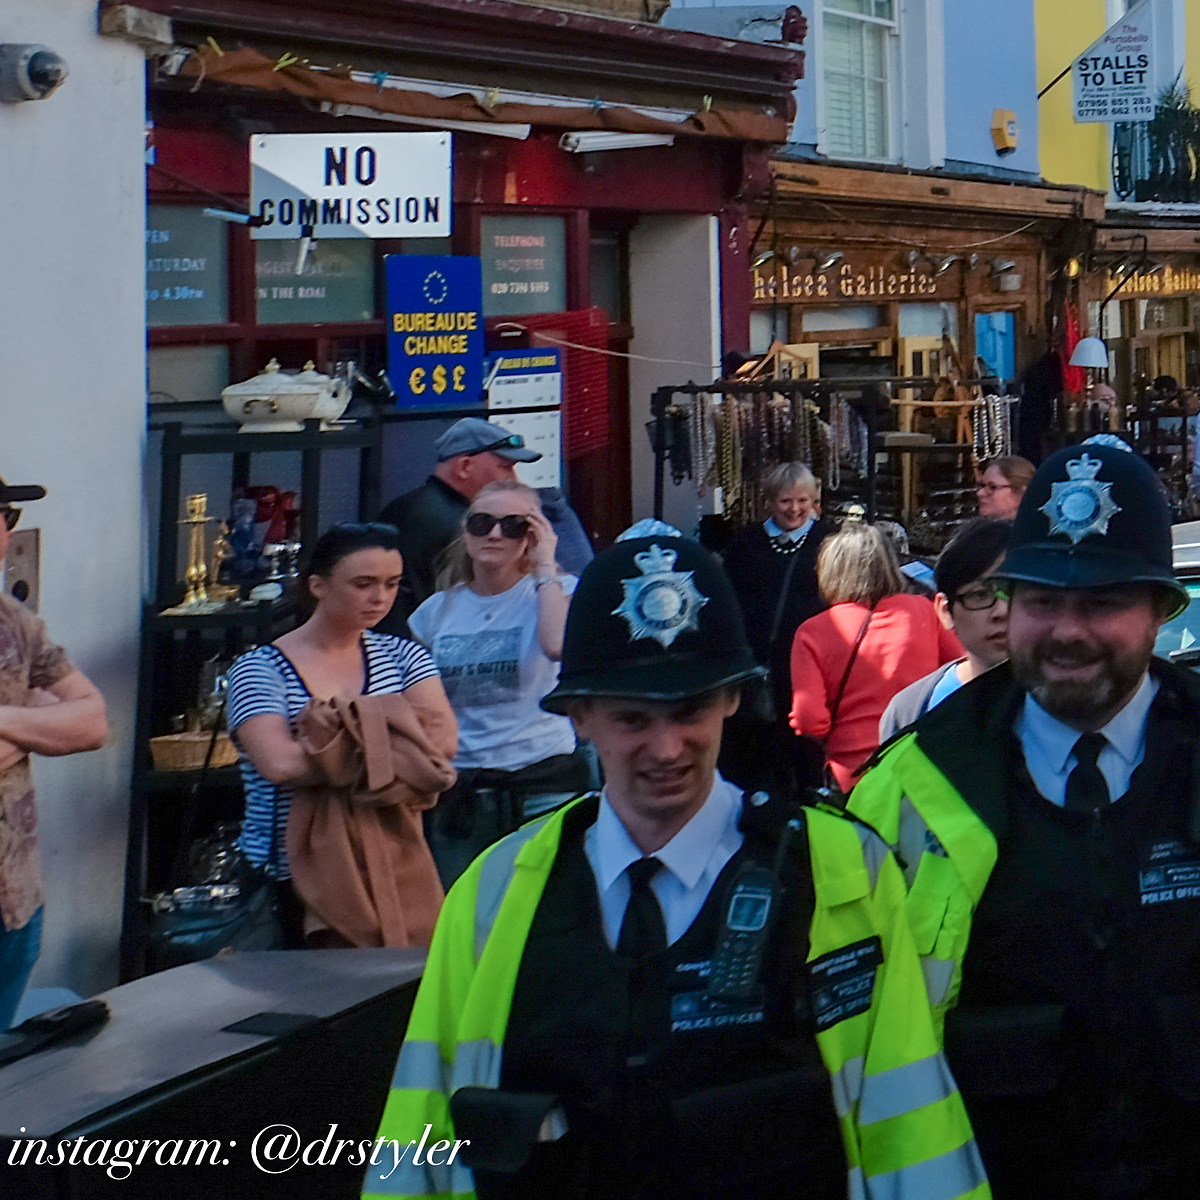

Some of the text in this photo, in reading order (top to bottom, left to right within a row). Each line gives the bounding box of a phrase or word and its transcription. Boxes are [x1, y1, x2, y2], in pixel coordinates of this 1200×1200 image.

[1115, 44, 1142, 52] Group
[1079, 55, 1149, 71] STALLS
[1080, 71, 1147, 86] TO LET
[324, 146, 378, 186] NO
[259, 197, 440, 226] COMMISSION
[147, 258, 206, 272] ATURDAY
[753, 263, 938, 299] helsea Galleries
[394, 312, 477, 332] BUREAU DE
[404, 334, 469, 355] CHANGE
[409, 364, 466, 395] € $ £
[672, 1018, 712, 1031] POLICE
